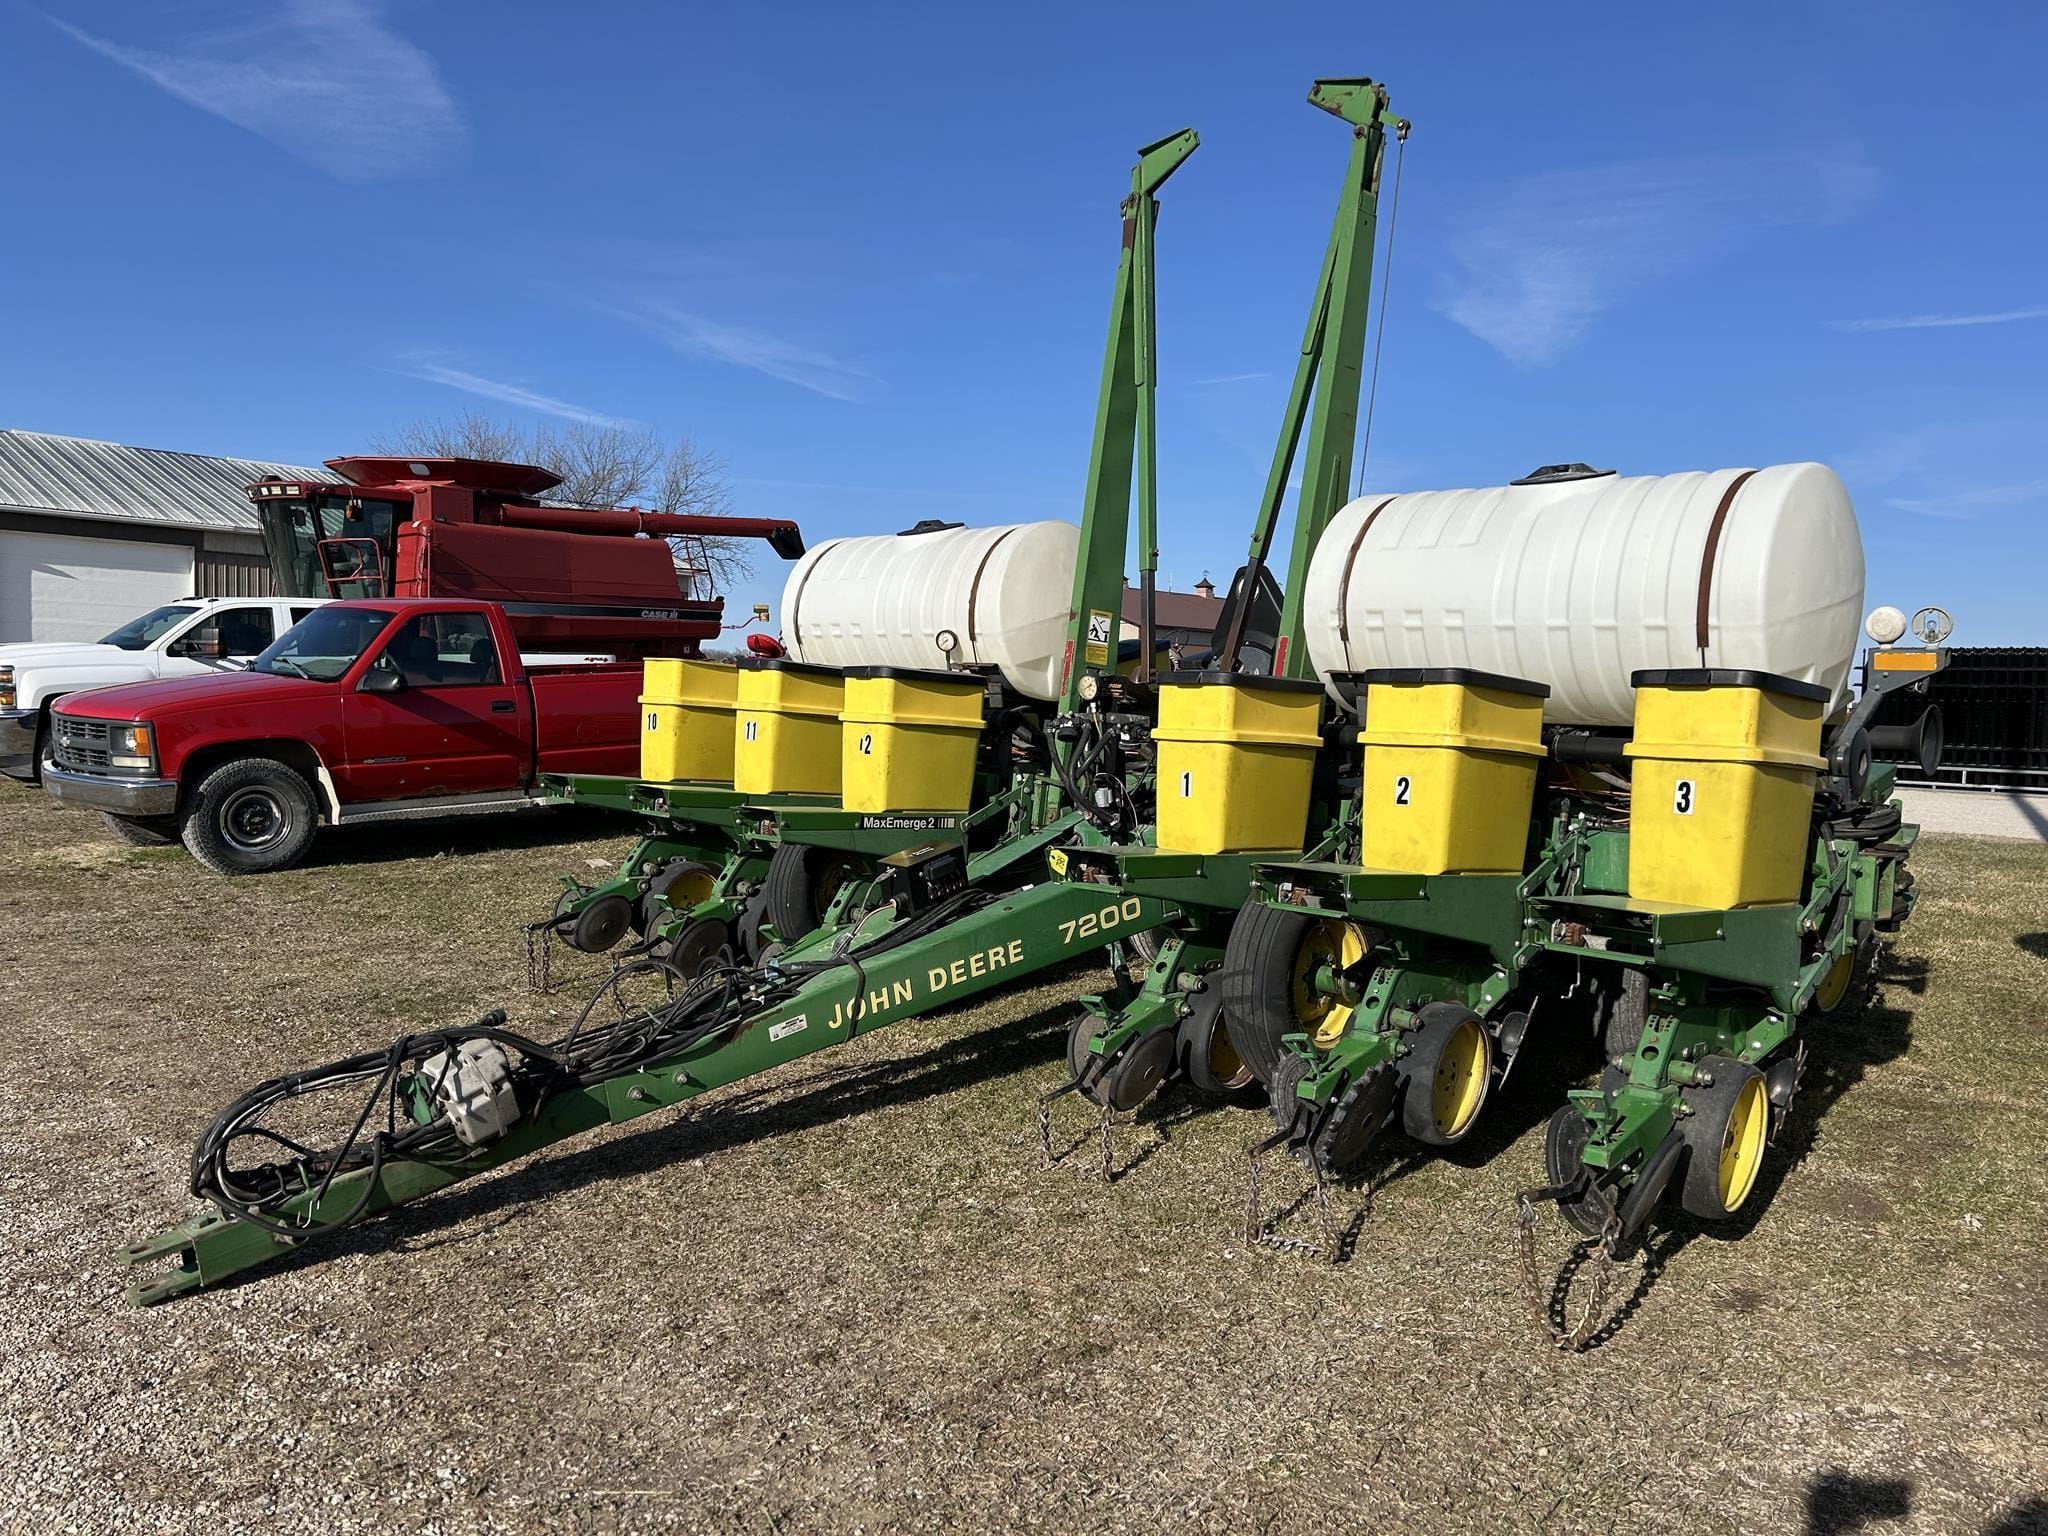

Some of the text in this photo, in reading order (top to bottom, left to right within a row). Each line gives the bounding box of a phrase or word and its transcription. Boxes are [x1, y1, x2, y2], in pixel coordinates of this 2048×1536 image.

[641, 609, 668, 619] CASE
[648, 713, 657, 730] 10
[747, 722, 756, 741] 11
[1184, 772, 1190, 797] 1
[1396, 777, 1410, 805] 2
[1676, 781, 1691, 813] 3
[864, 816, 935, 831] MaxEmerge 2
[1059, 897, 1141, 945] 7200
[827, 939, 1025, 1030] JOHN DEERE
